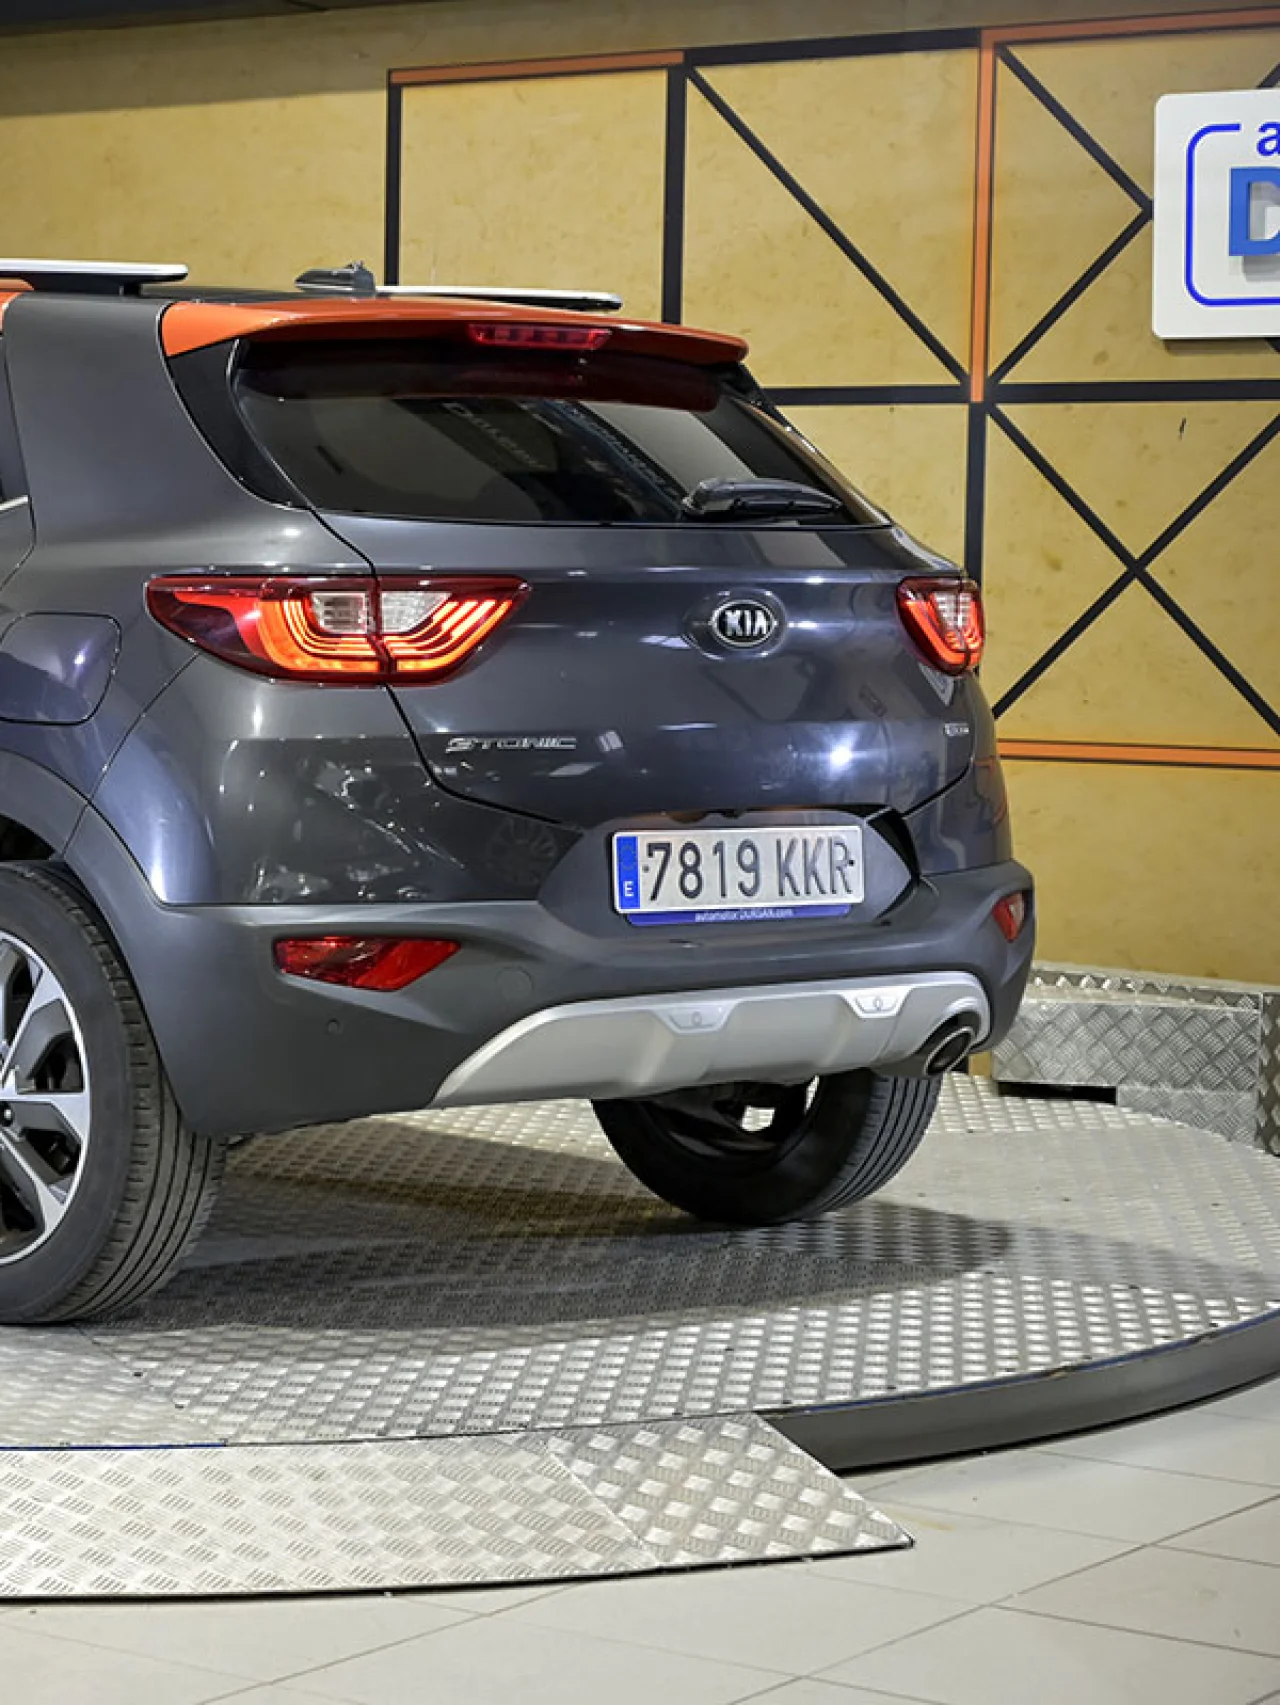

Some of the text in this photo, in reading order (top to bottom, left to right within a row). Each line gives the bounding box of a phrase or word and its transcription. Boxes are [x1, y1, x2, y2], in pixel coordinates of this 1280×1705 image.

[725, 609, 767, 637] KIA
[446, 737, 577, 753] STONIC
[647, 836, 854, 901] 7819 KKR
[623, 880, 635, 897] E
